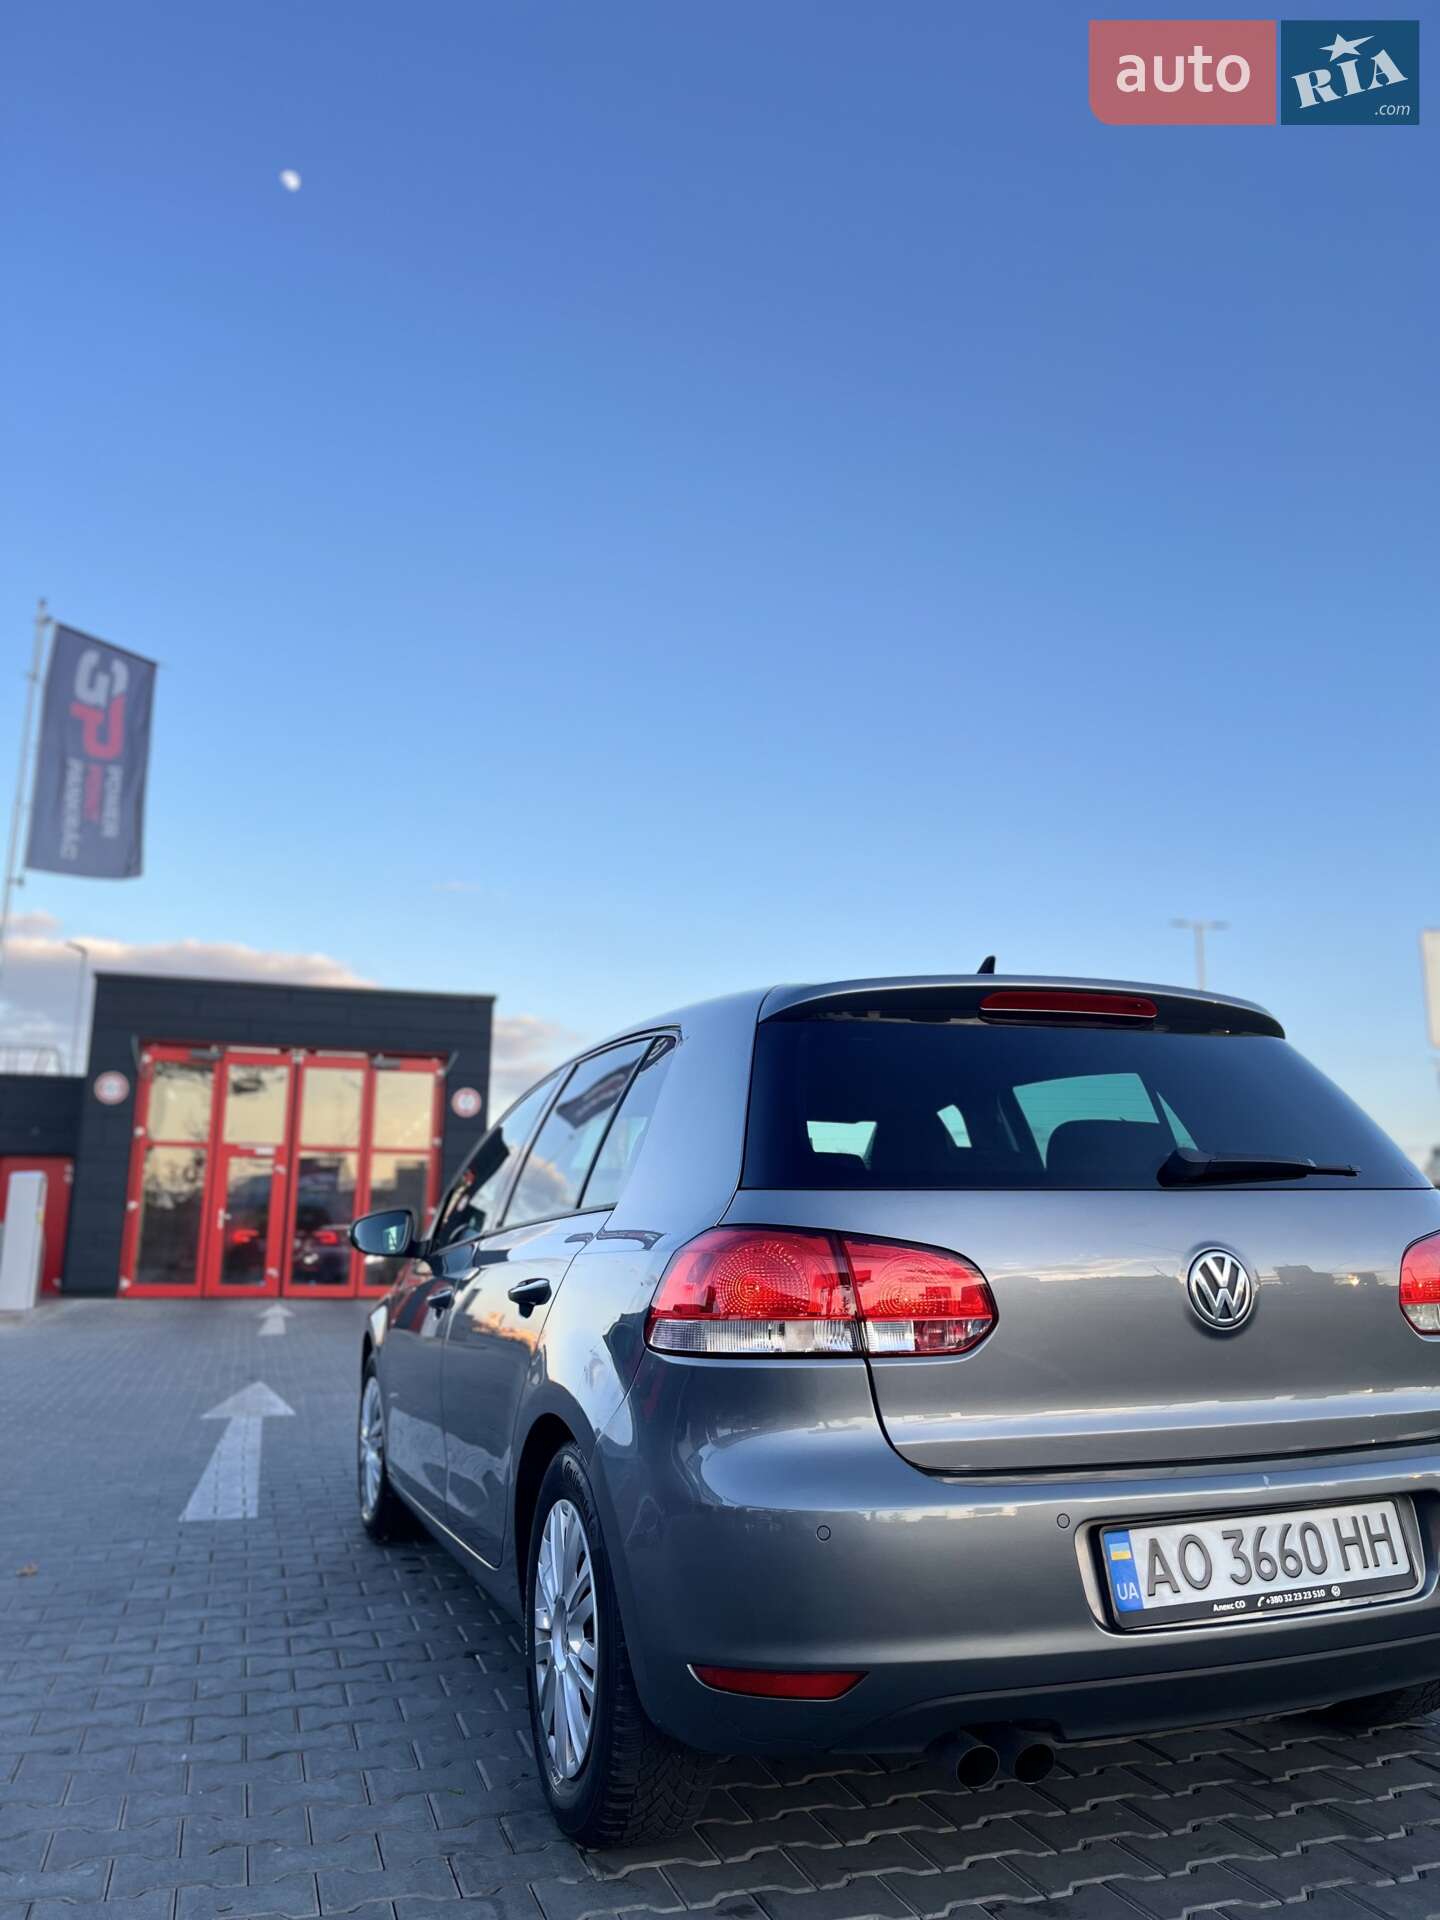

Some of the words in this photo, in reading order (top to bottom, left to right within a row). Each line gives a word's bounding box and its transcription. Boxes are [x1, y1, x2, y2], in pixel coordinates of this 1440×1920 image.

[1147, 1533, 1213, 1597] AO
[1221, 1520, 1329, 1586] 3660
[1332, 1512, 1399, 1572] HH
[1116, 1581, 1141, 1603] UA
[1284, 1594, 1293, 1602] 32
[1293, 1592, 1302, 1601] 23
[1303, 1591, 1312, 1600] 23
